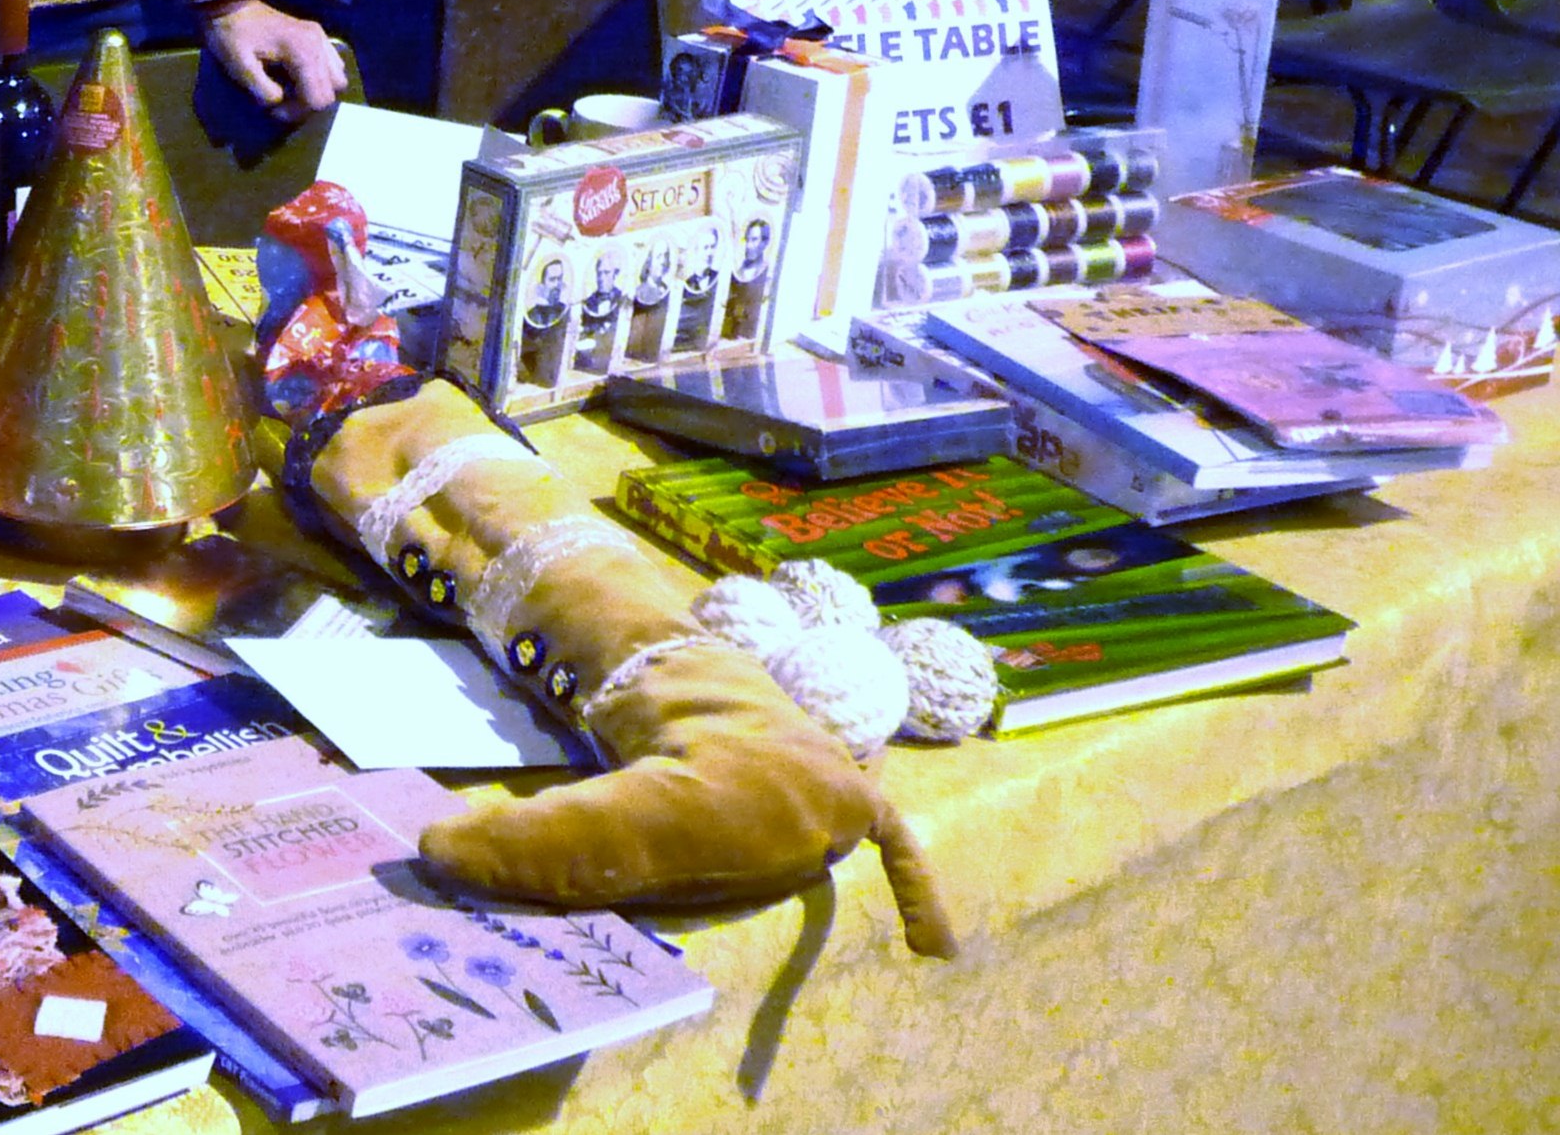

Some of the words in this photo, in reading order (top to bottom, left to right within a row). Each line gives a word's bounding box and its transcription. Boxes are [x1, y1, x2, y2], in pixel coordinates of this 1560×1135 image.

[913, 20, 1041, 61] TABLE
[970, 100, 1014, 138] £1
[687, 178, 702, 206] 5
[760, 480, 940, 543] Believe
[863, 529, 929, 560] or
[902, 489, 1025, 543] Not!
[34, 727, 156, 780] Quilt
[143, 719, 201, 744] &
[222, 818, 359, 860] STITCHED
